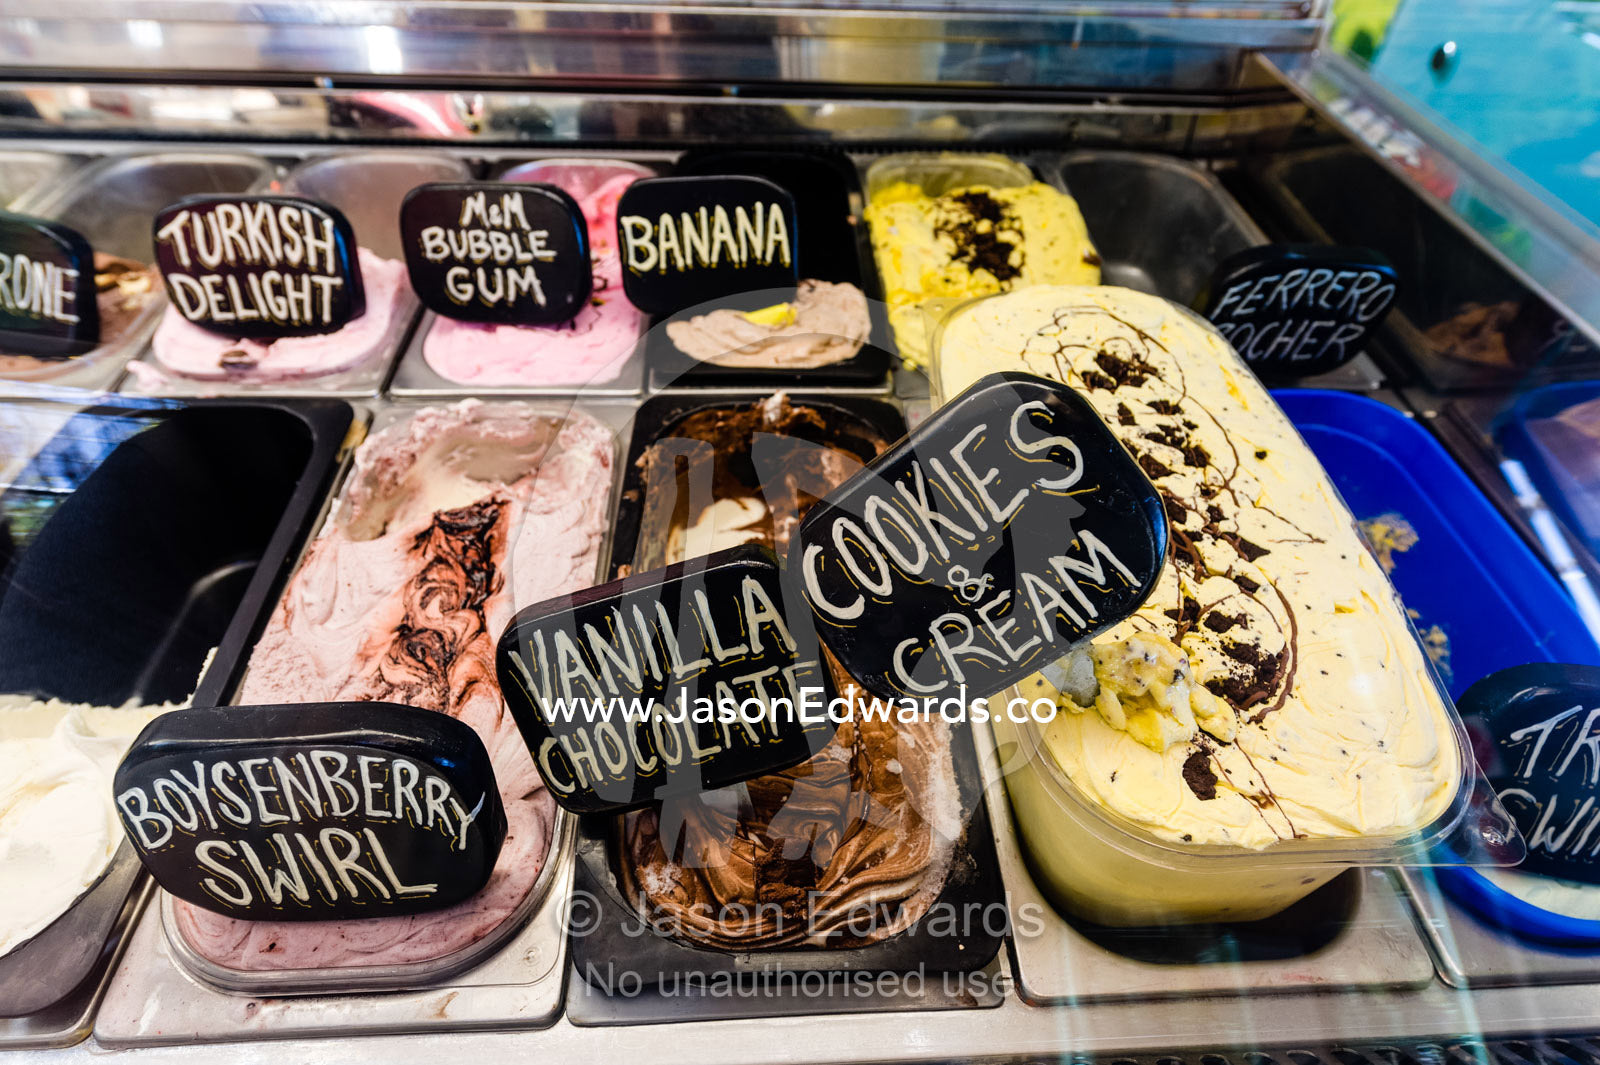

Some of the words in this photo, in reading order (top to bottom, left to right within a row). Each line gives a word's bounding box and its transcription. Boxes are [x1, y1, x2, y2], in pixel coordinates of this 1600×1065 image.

[157, 201, 336, 275] TURKISH
[421, 226, 557, 263] BUBBLE
[462, 191, 531, 231] M&M
[621, 202, 791, 272] BANANA
[167, 270, 343, 324] DELIGHT
[446, 265, 546, 306] GUM
[1209, 268, 1396, 322] FERRERO
[802, 400, 1084, 620] COOKIES
[893, 529, 1142, 693] CREAM
[948, 565, 995, 601] &
[508, 575, 797, 722] VANILLA
[539, 660, 836, 794] CHOCOLATE
[117, 750, 486, 850] BOYSENBERRY
[1491, 788, 1600, 856] SWI
[195, 827, 438, 905] SWIRL
